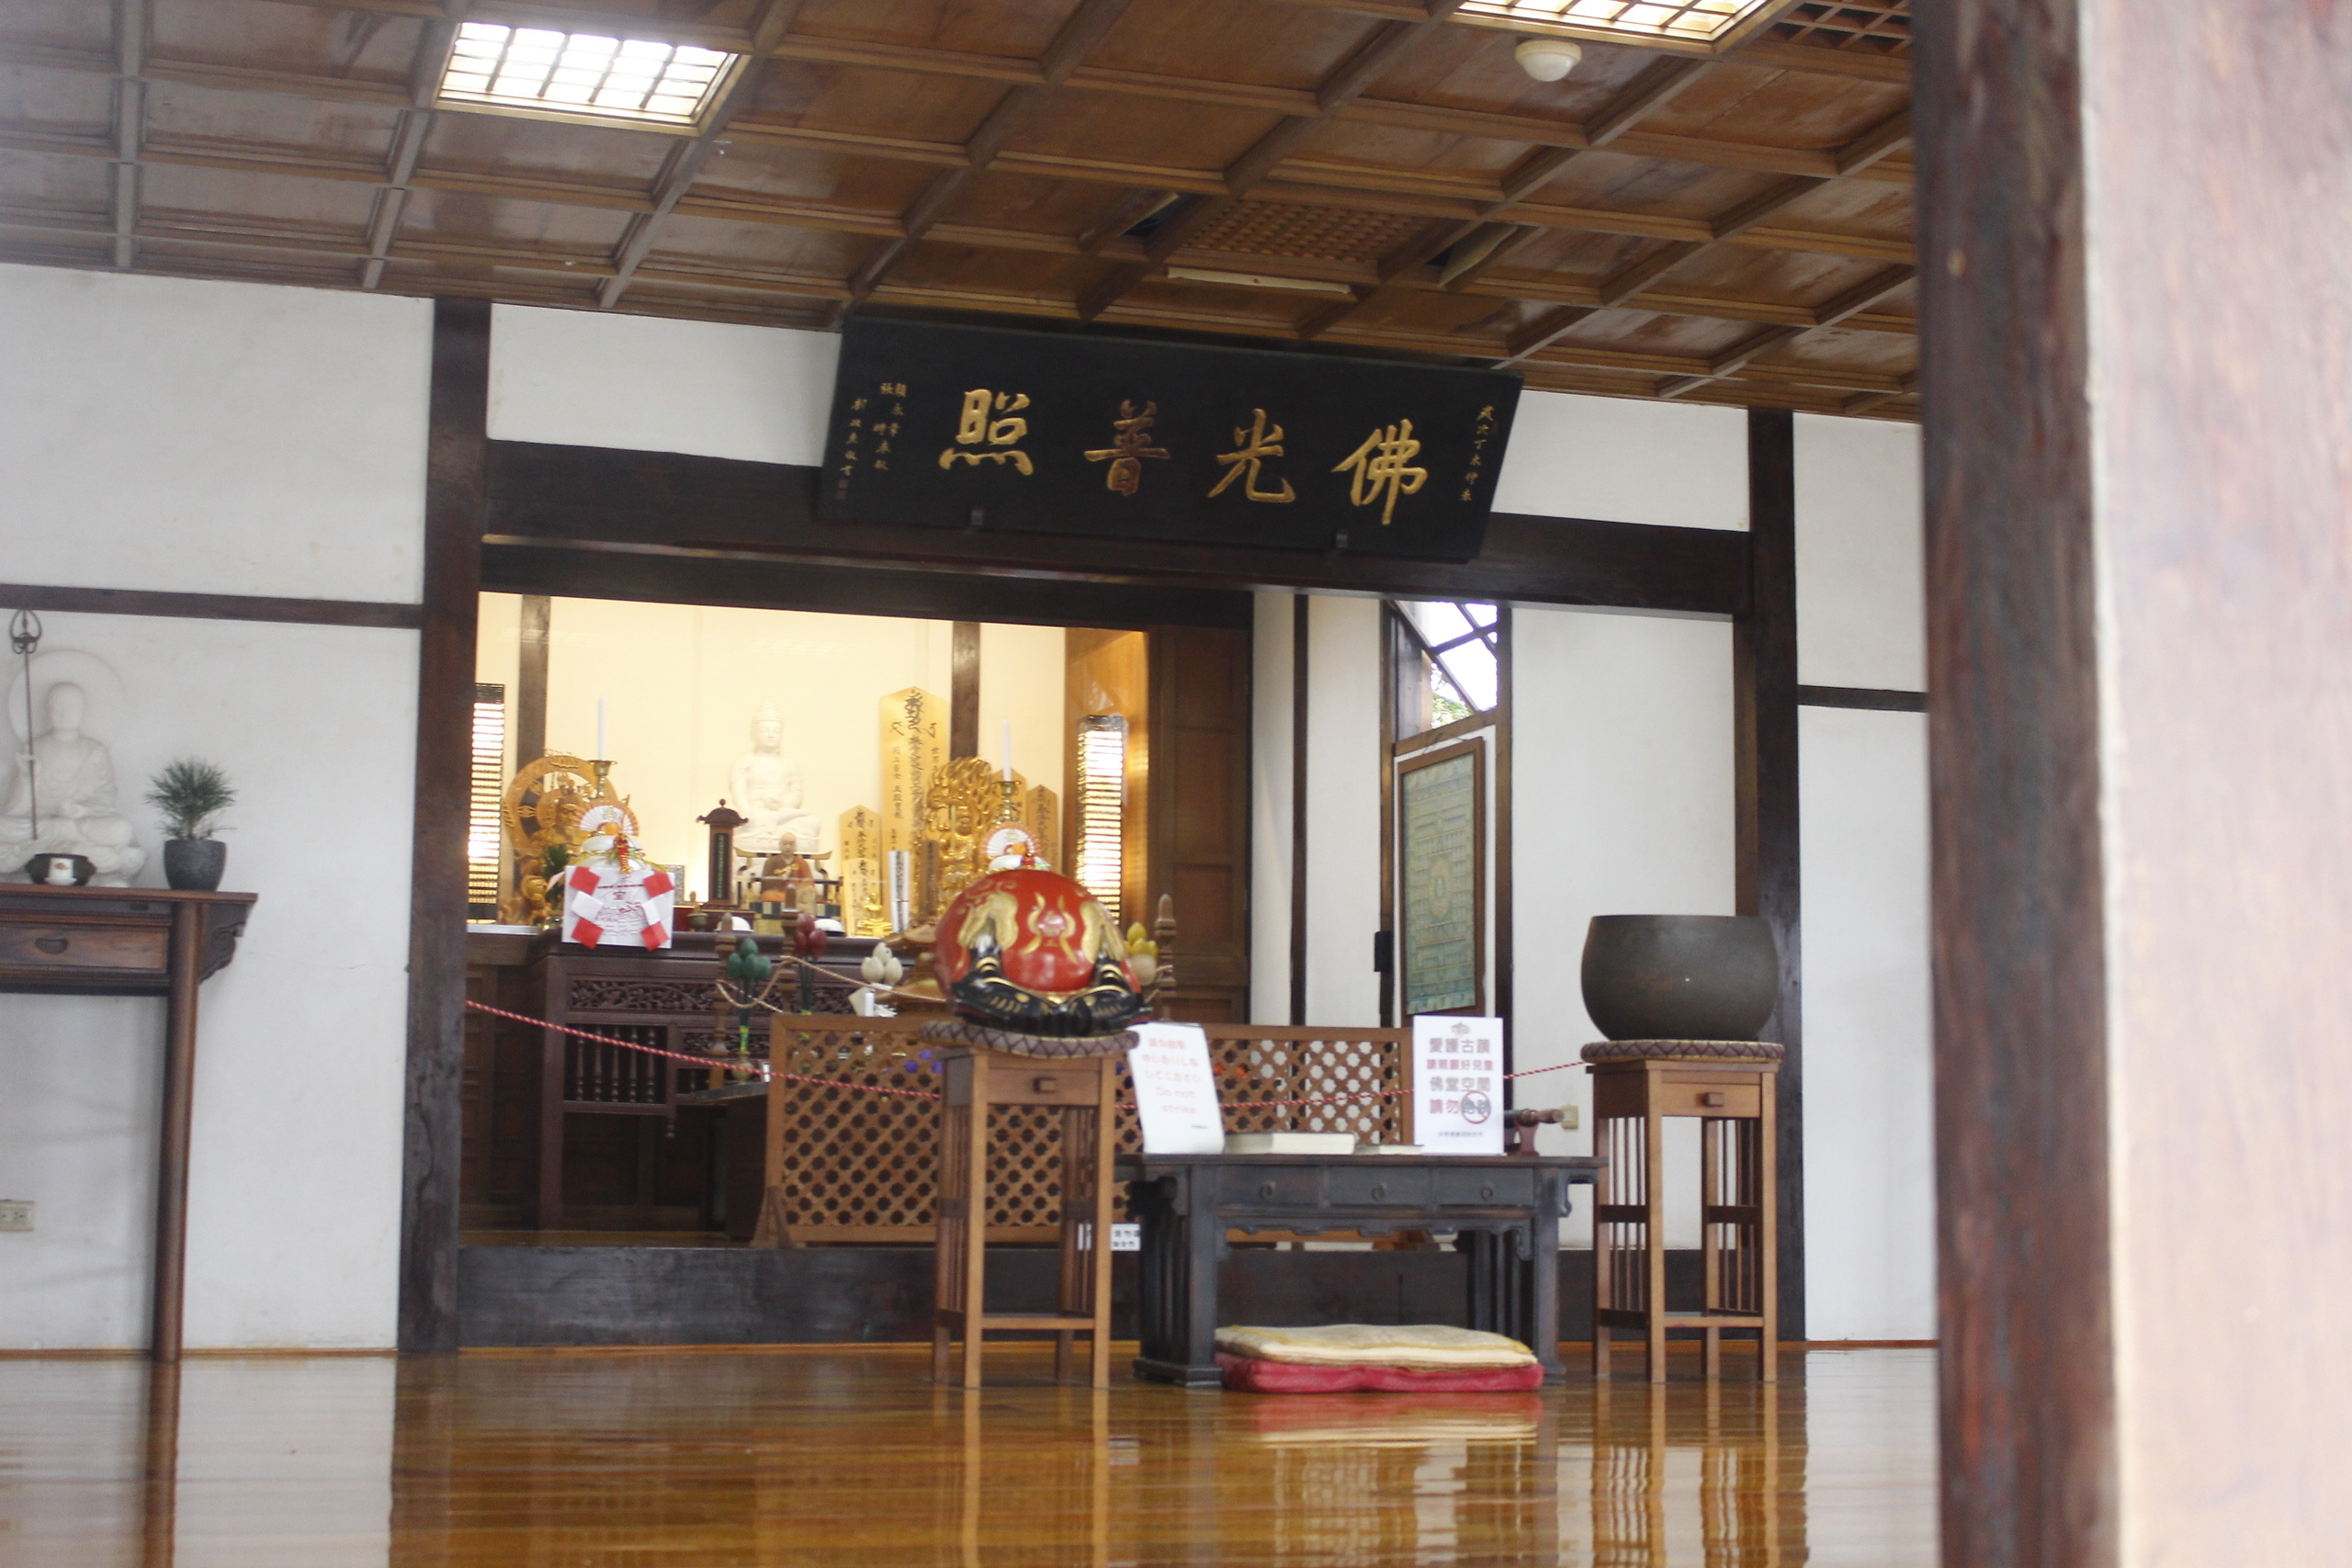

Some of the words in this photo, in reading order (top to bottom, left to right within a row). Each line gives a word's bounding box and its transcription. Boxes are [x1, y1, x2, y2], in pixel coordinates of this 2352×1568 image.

[938, 388, 1429, 525] 佛光普照
[1430, 1038, 1490, 1054] 愛護古蹟
[1430, 1077, 1490, 1092] 佛堂空間
[1157, 1088, 1171, 1097] Do
